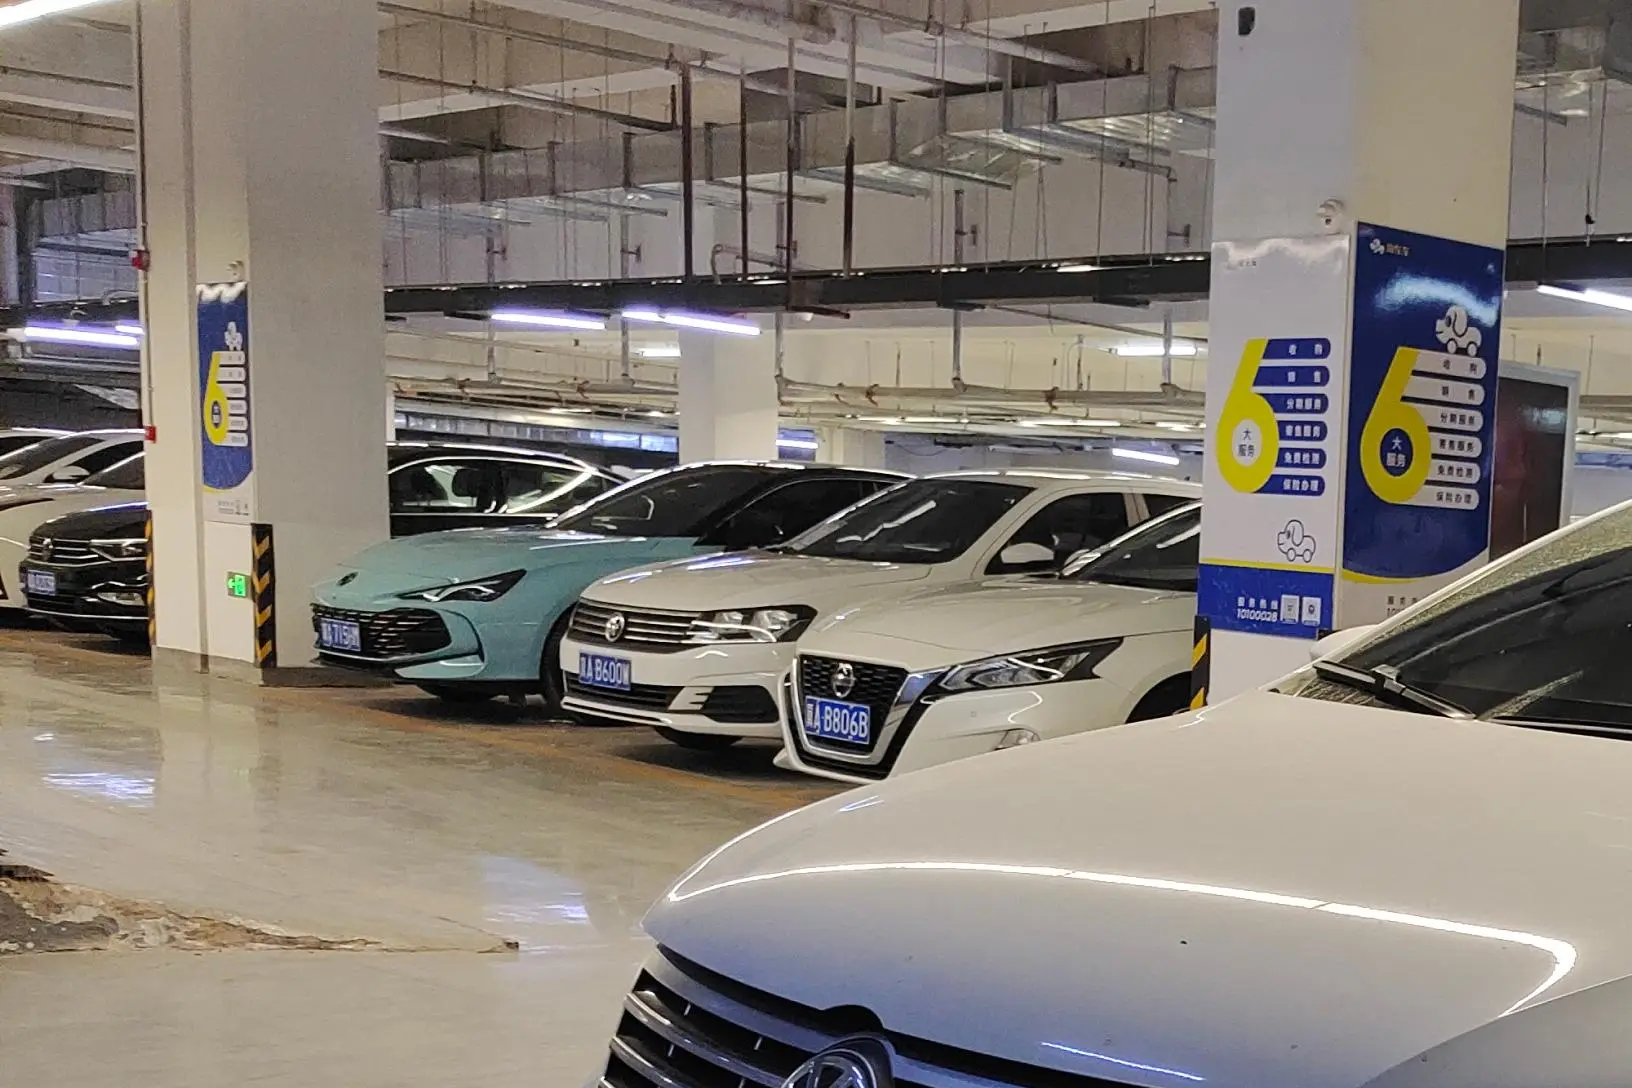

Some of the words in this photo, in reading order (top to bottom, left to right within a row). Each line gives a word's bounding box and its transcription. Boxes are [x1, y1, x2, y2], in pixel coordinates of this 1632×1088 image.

[1216, 338, 1279, 494] 6
[1360, 346, 1432, 505] 6
[1243, 429, 1252, 441] 大
[1391, 435, 1403, 450] 大
[1238, 444, 1256, 458] 服务
[1386, 452, 1407, 468] 服务
